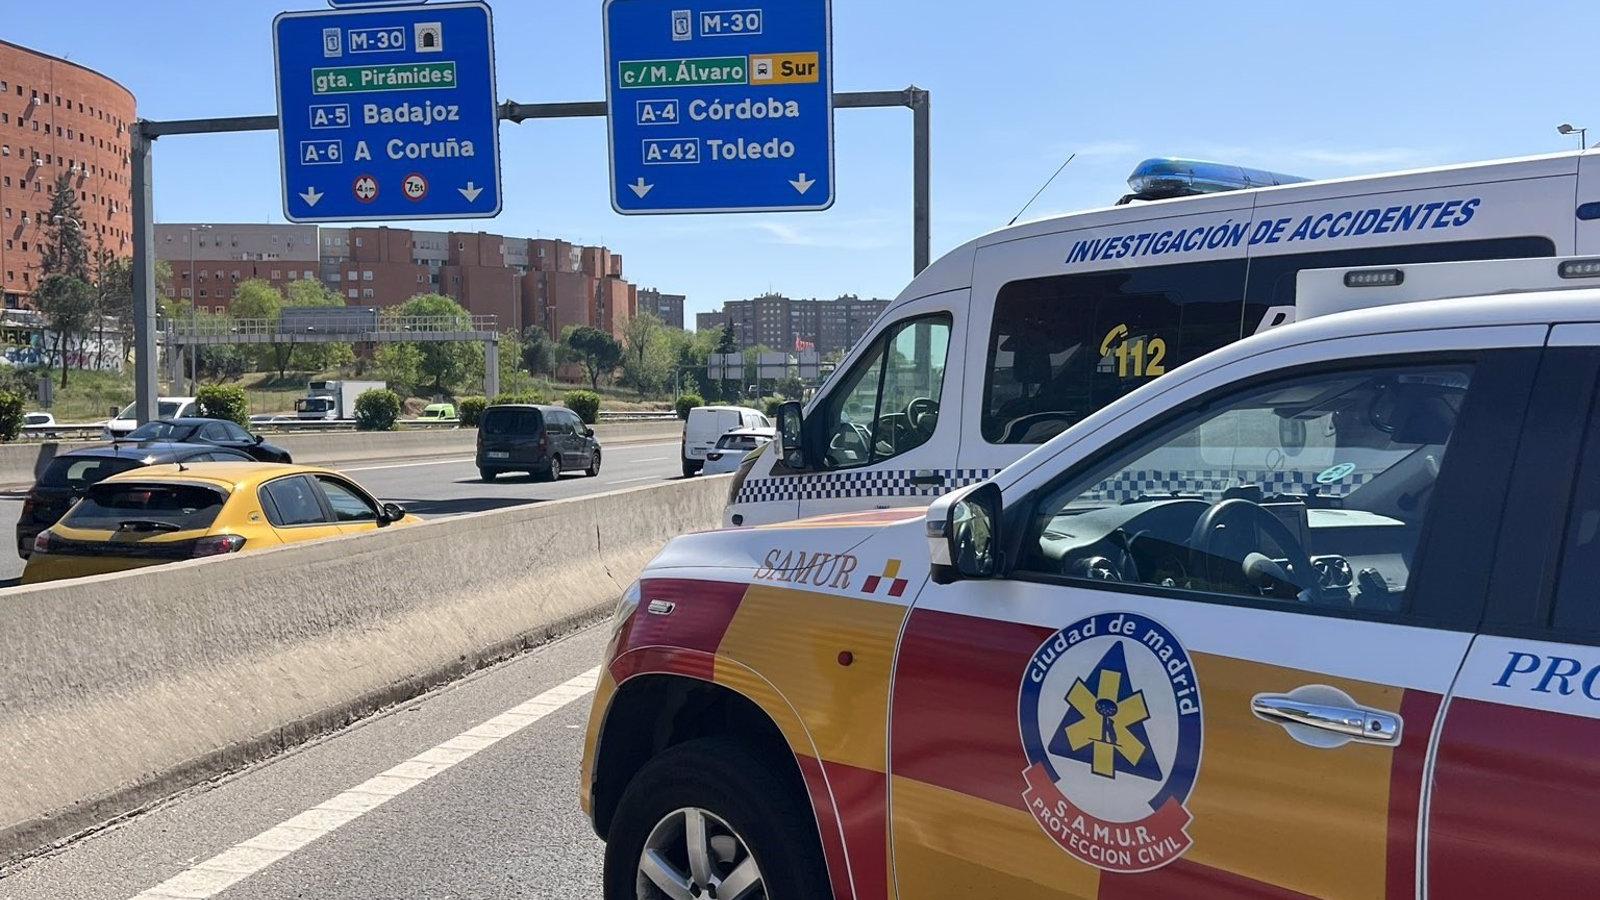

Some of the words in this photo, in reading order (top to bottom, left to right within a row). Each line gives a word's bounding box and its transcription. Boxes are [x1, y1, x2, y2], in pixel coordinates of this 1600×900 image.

[703, 13, 759, 33] M-30
[351, 31, 403, 50] M-30
[316, 74, 353, 91] gta.
[361, 67, 453, 86] Pirámides
[781, 60, 816, 77] Sur
[314, 108, 347, 125] A-5
[363, 101, 459, 125] Badajoz
[641, 104, 676, 122] A-4
[688, 98, 800, 121] Córdoba
[304, 144, 338, 161] A-6
[354, 141, 372, 161] A
[386, 138, 475, 160] Coruña
[646, 143, 696, 160] A-42
[706, 138, 795, 160] Toledo
[1065, 219, 1251, 264] INVESTIGACIÓN
[1249, 217, 1292, 245] DE
[1288, 198, 1481, 242] ACCIDENTES
[1114, 338, 1166, 377] 112
[753, 549, 858, 589] SAMUR
[1031, 617, 1096, 684] ciudad
[1108, 614, 1136, 635] de
[1142, 629, 1199, 716] madrid
[1033, 797, 1131, 865] PROTECCION
[1138, 835, 1181, 864] CIVIL
